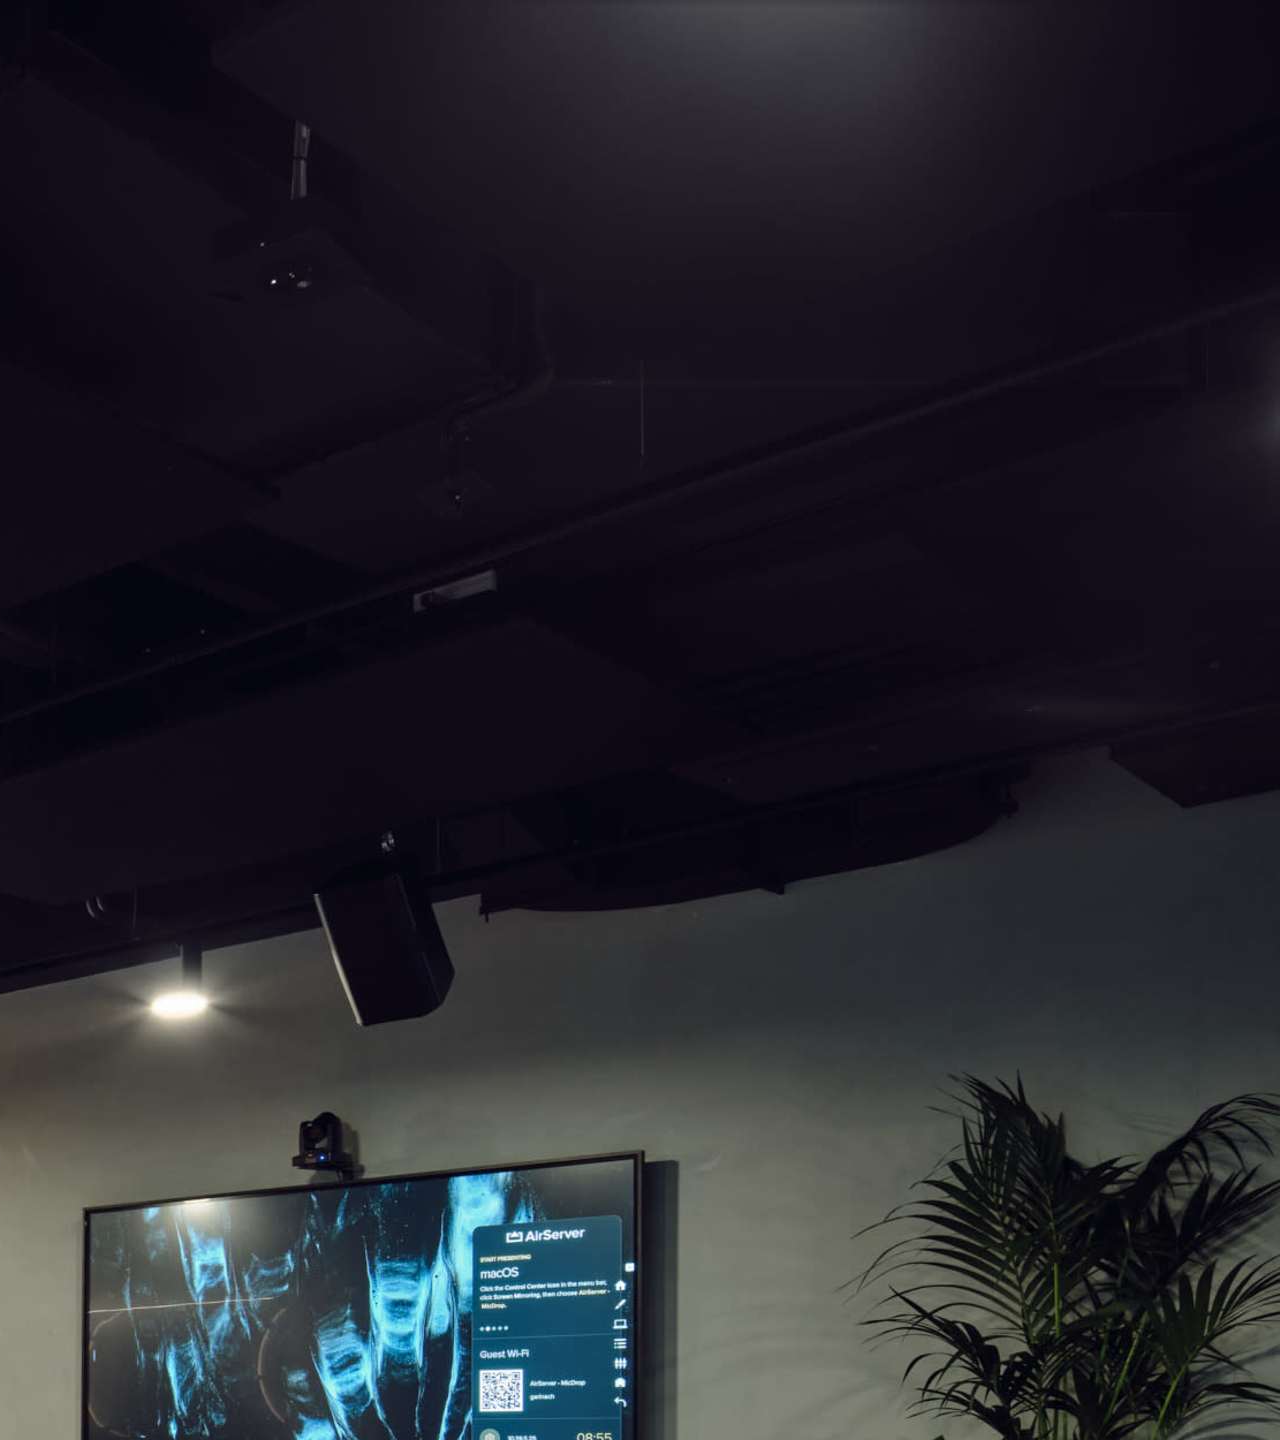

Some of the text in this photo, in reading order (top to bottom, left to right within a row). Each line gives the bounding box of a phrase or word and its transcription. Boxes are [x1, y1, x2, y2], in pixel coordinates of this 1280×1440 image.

[525, 1229, 586, 1242] AirServer
[480, 1266, 519, 1279] macOS
[479, 1348, 530, 1359] Guest Wi-Fi
